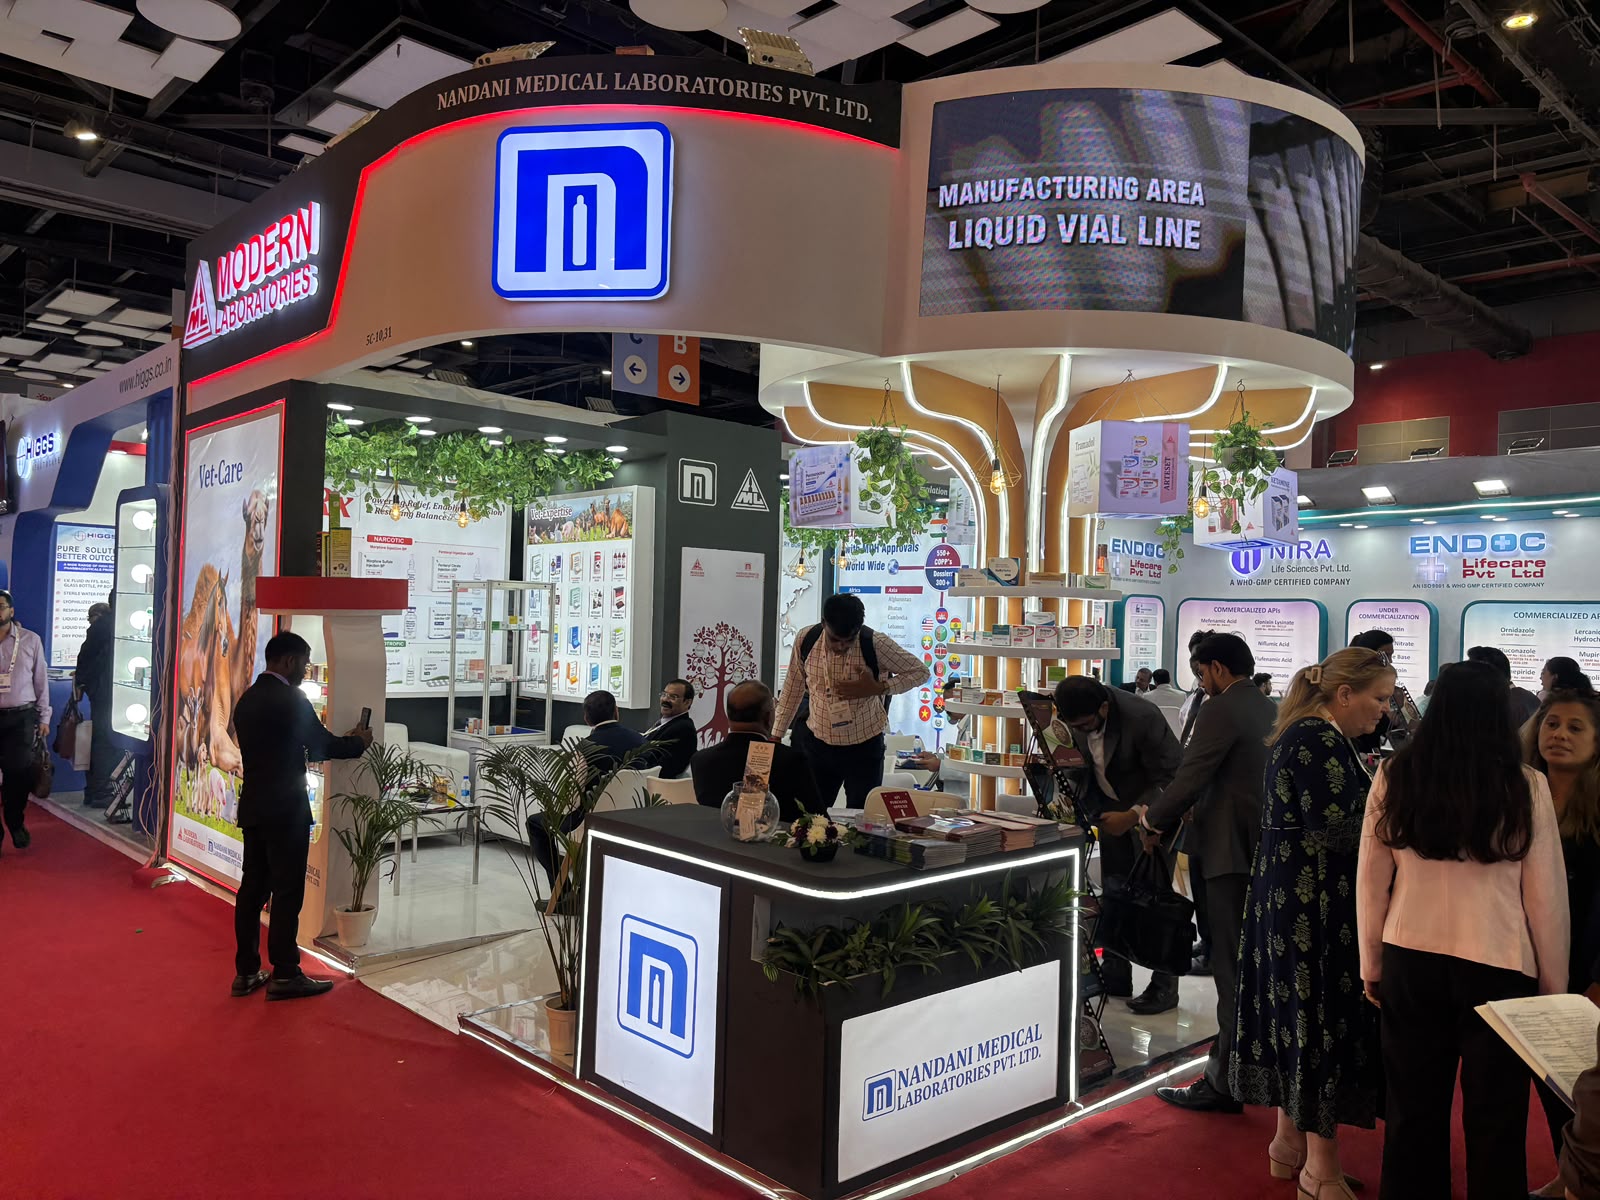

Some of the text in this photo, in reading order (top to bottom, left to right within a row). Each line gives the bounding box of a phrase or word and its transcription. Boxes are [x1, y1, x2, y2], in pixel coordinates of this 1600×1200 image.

[436, 72, 873, 123] NANDANI MEDICAL LABORATORIES PVT. LTD.
[938, 175, 1205, 208] MANUFACTURING AREA
[948, 213, 1201, 251] LIQUID VIAL LINE
[217, 201, 317, 301] MODERN
[215, 264, 316, 335] LABORATORIES
[673, 335, 687, 354] B
[119, 357, 172, 393] www.higgs.co.in
[26, 432, 54, 460] HIGGS
[199, 459, 243, 488] Vet-Care
[530, 506, 573, 521] Vet-Expertise
[374, 536, 404, 544] NARCOTIC
[1112, 538, 1166, 558] ENDOC
[1270, 539, 1332, 560] NIRA
[1410, 532, 1546, 554] ENDOC
[56, 552, 88, 560] BETTER
[872, 561, 886, 570] Wide
[1130, 560, 1162, 570] Lifecare
[1462, 558, 1546, 568] Lifecare
[1130, 568, 1162, 578] Pvt Ltd
[1272, 564, 1352, 573] Life Sciences Pvt. Ltd.
[1462, 569, 1544, 579] Pvt Ltd
[1513, 611, 1588, 619] COMMERCIALIZED
[897, 1023, 1043, 1091] NANDANI MEDICAL
[896, 1046, 1042, 1111] LABORATORIES PVT. LTD.
